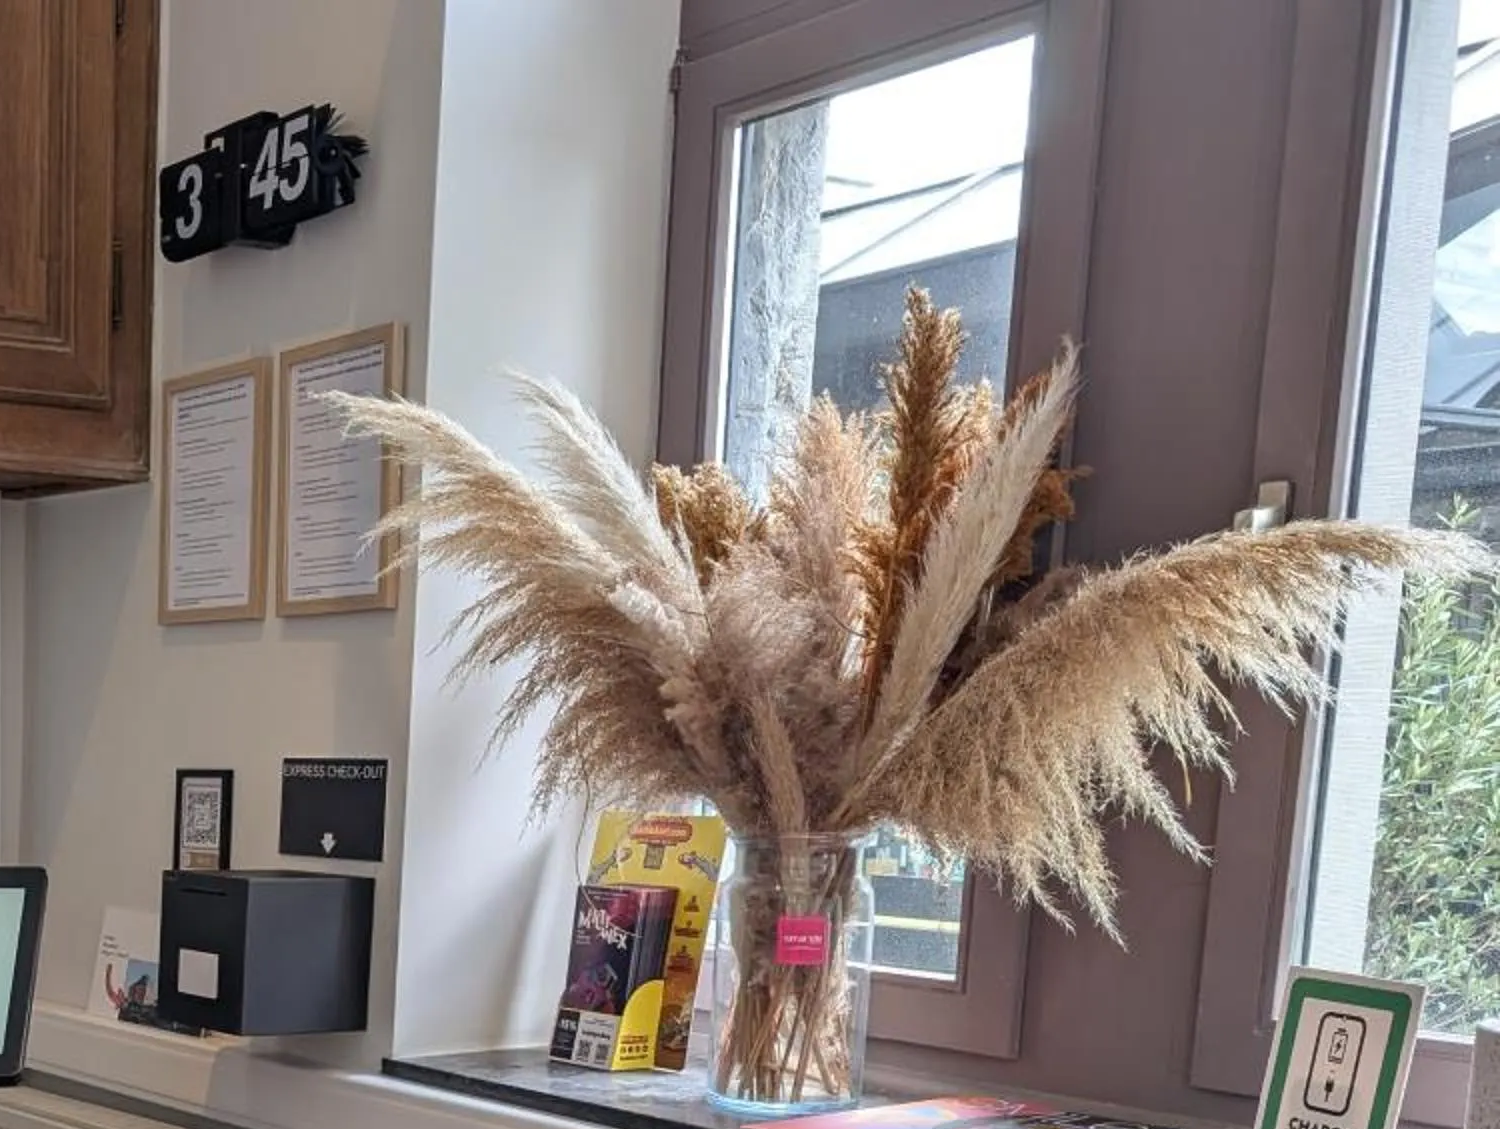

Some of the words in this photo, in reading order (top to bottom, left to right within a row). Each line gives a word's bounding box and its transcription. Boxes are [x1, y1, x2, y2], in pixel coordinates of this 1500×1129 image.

[175, 163, 203, 240] 3
[249, 114, 311, 210] 45
[283, 764, 325, 777] EXPRESS
[327, 765, 385, 779] CHECK-OUT
